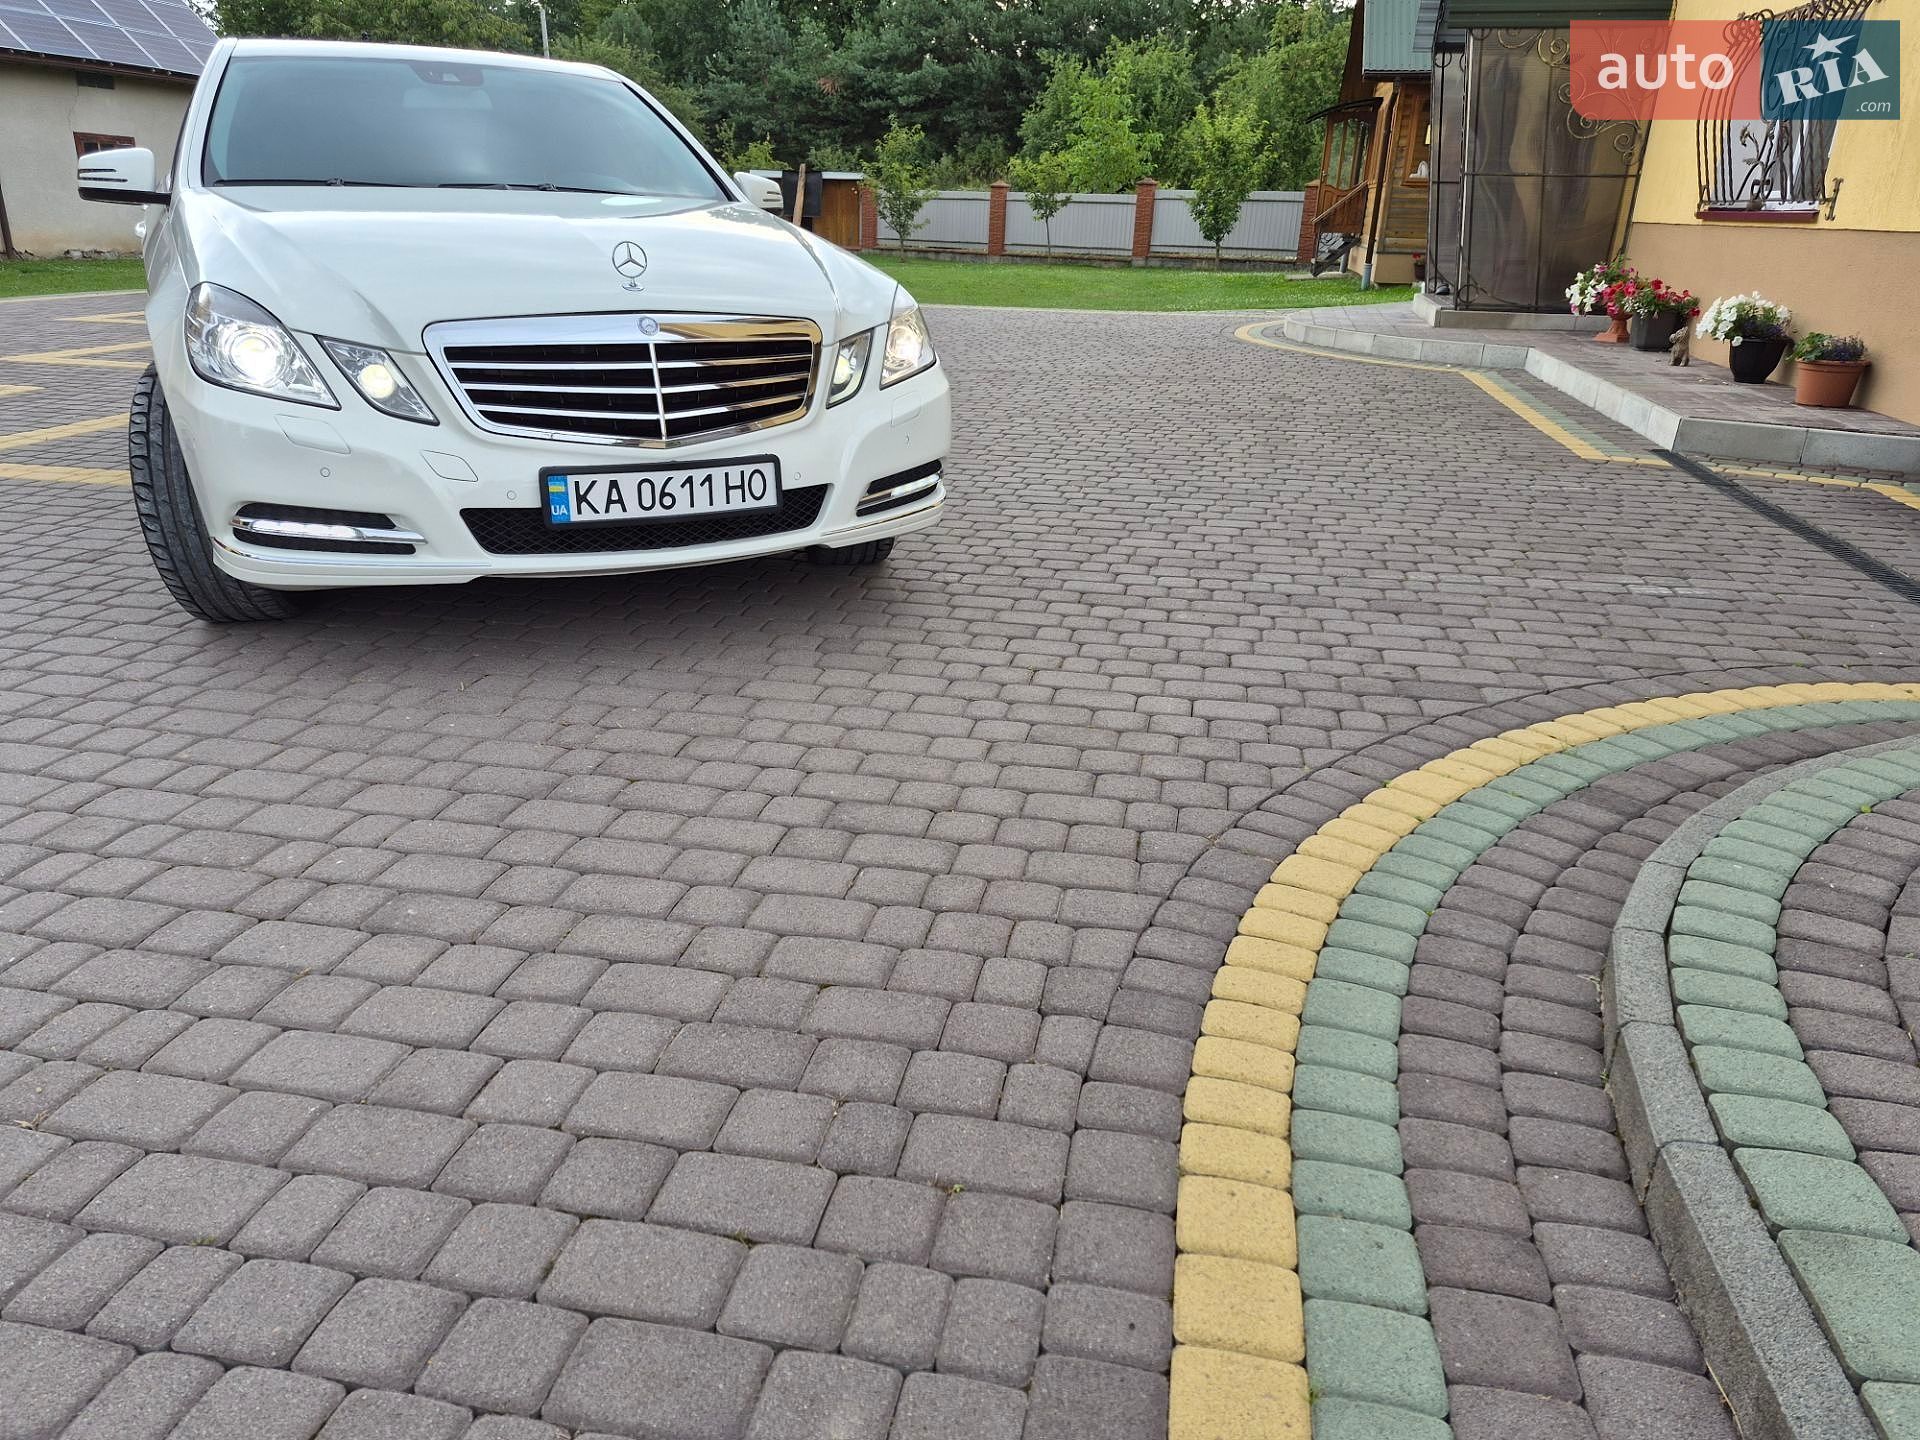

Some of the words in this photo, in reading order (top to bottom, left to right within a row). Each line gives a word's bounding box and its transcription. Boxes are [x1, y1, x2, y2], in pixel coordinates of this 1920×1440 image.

[574, 479, 628, 515] KA
[636, 473, 714, 512] 0611
[724, 468, 767, 505] HO
[551, 505, 568, 516] UA
